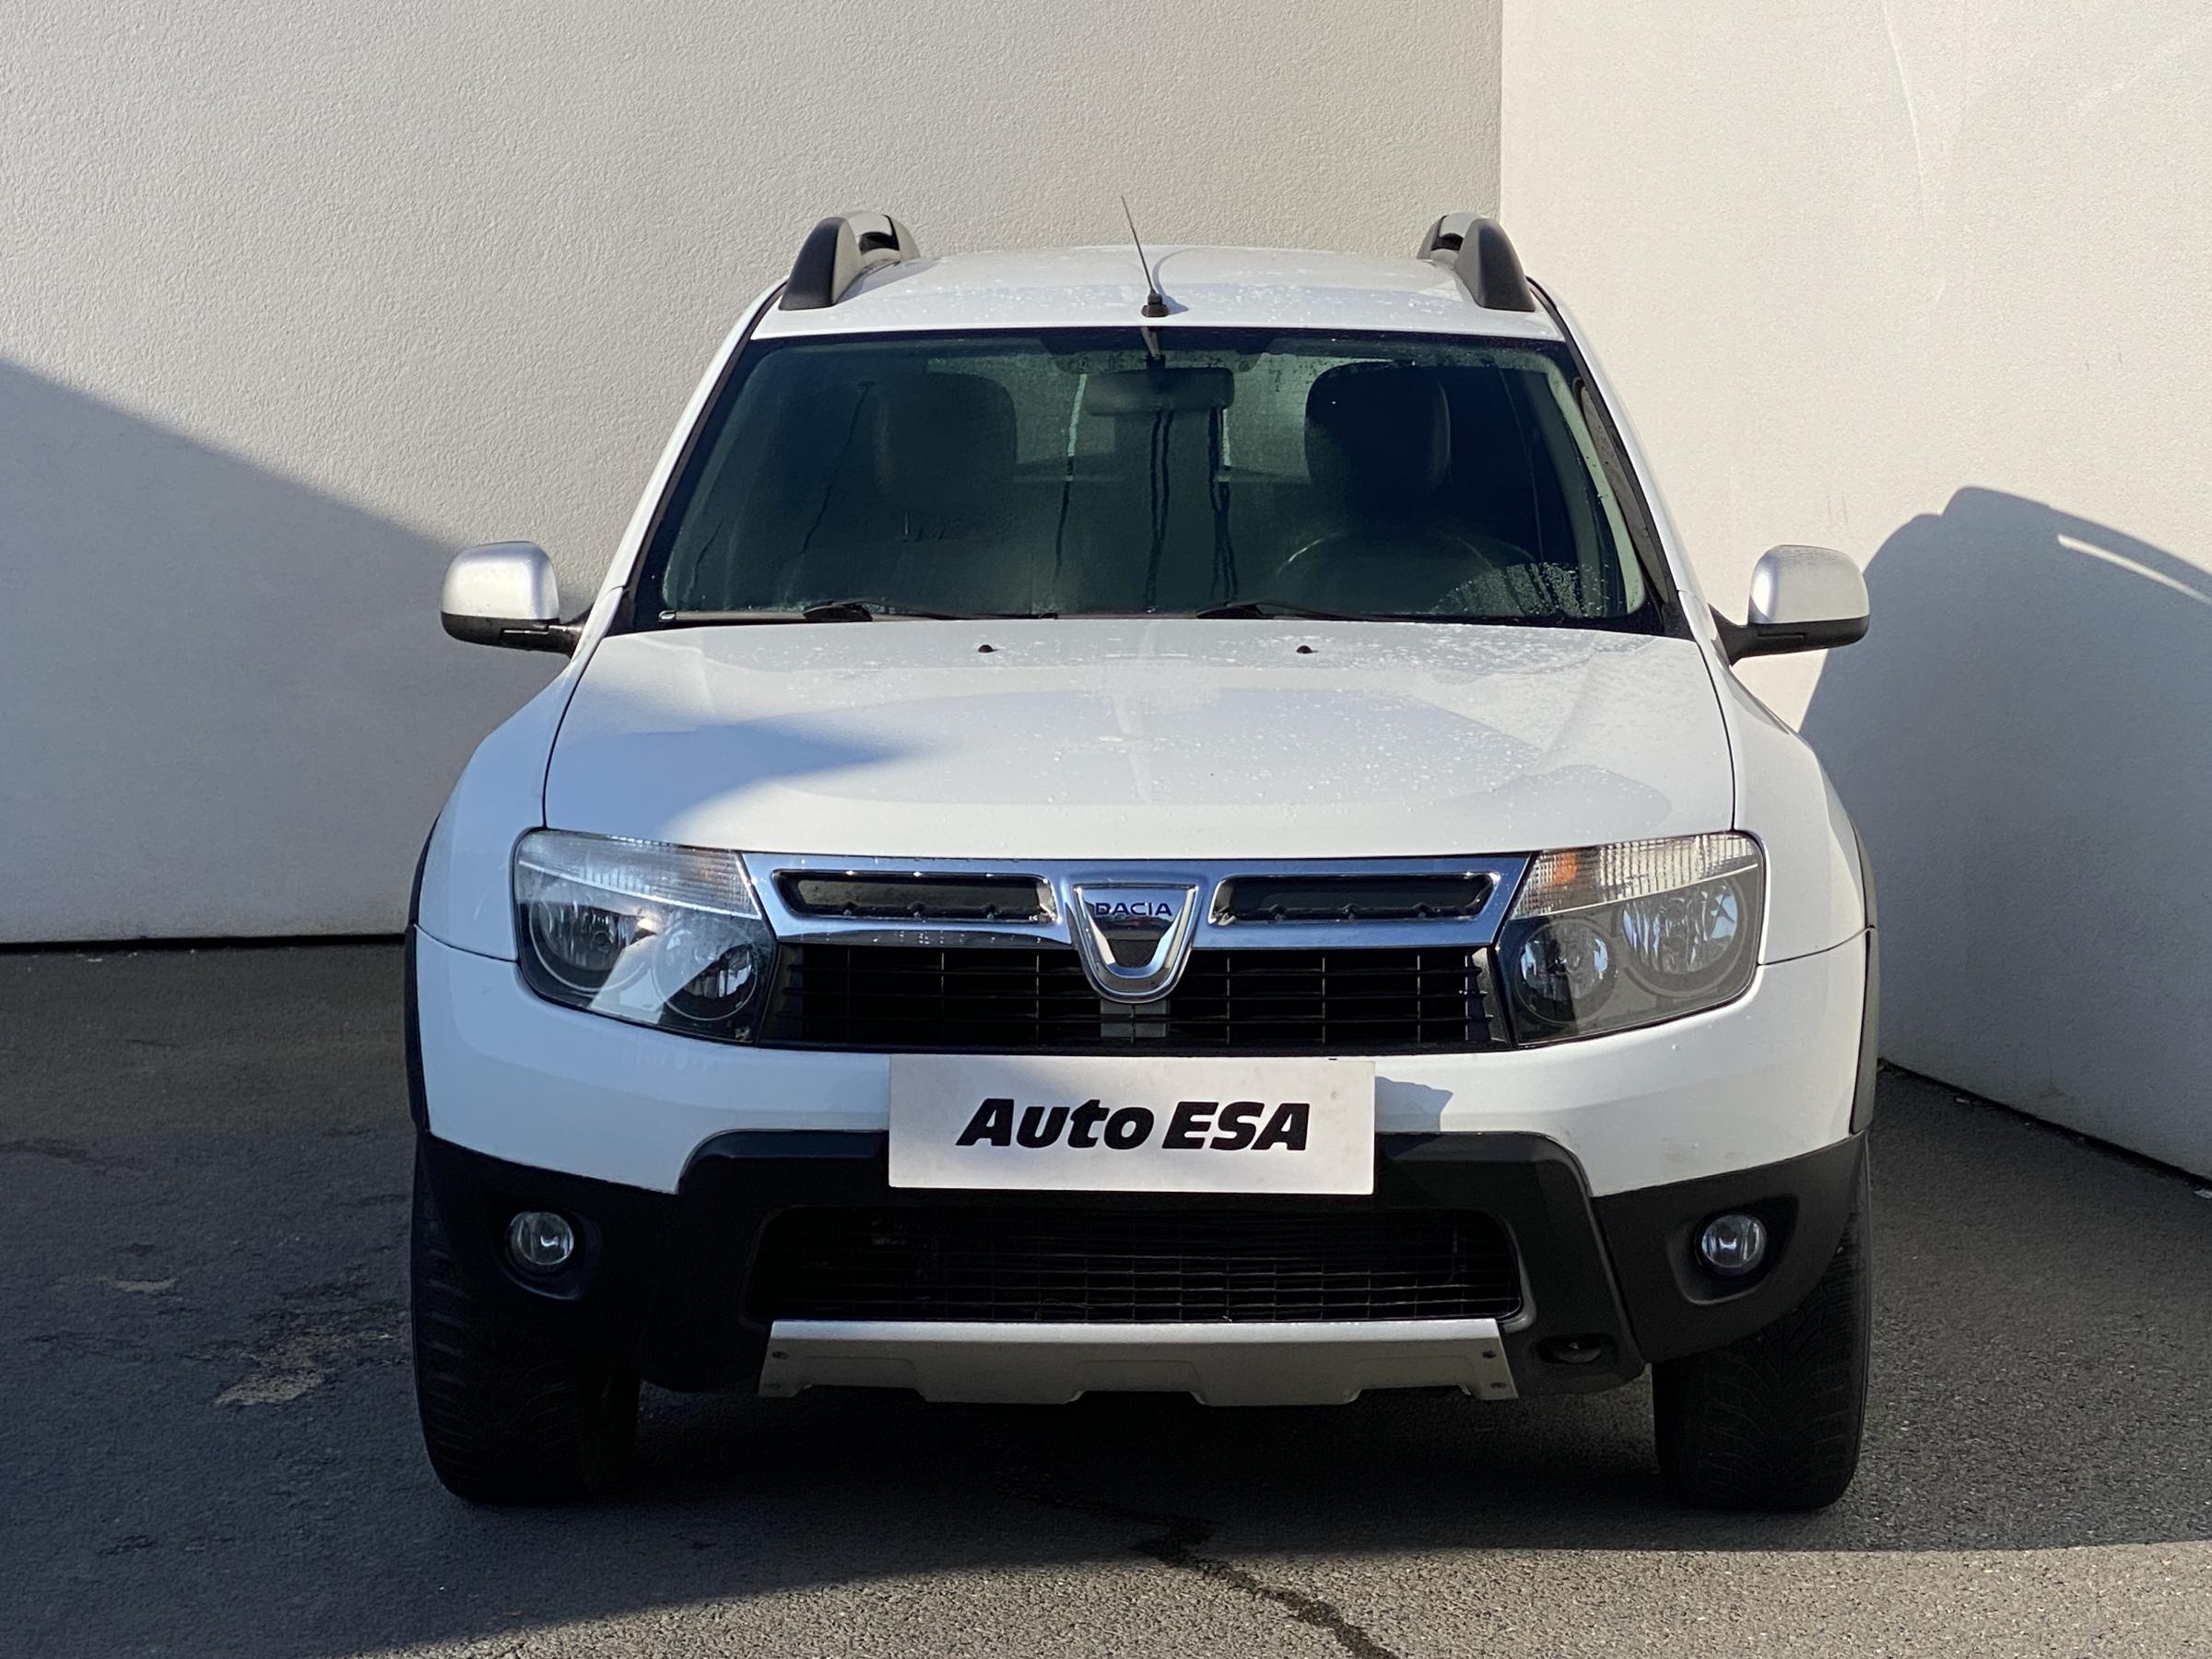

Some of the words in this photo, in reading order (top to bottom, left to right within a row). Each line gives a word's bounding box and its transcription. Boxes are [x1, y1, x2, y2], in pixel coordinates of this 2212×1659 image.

[1095, 902, 1172, 916] DACIA
[955, 1098, 1155, 1150] Auto
[1161, 1100, 1311, 1151] ESA
